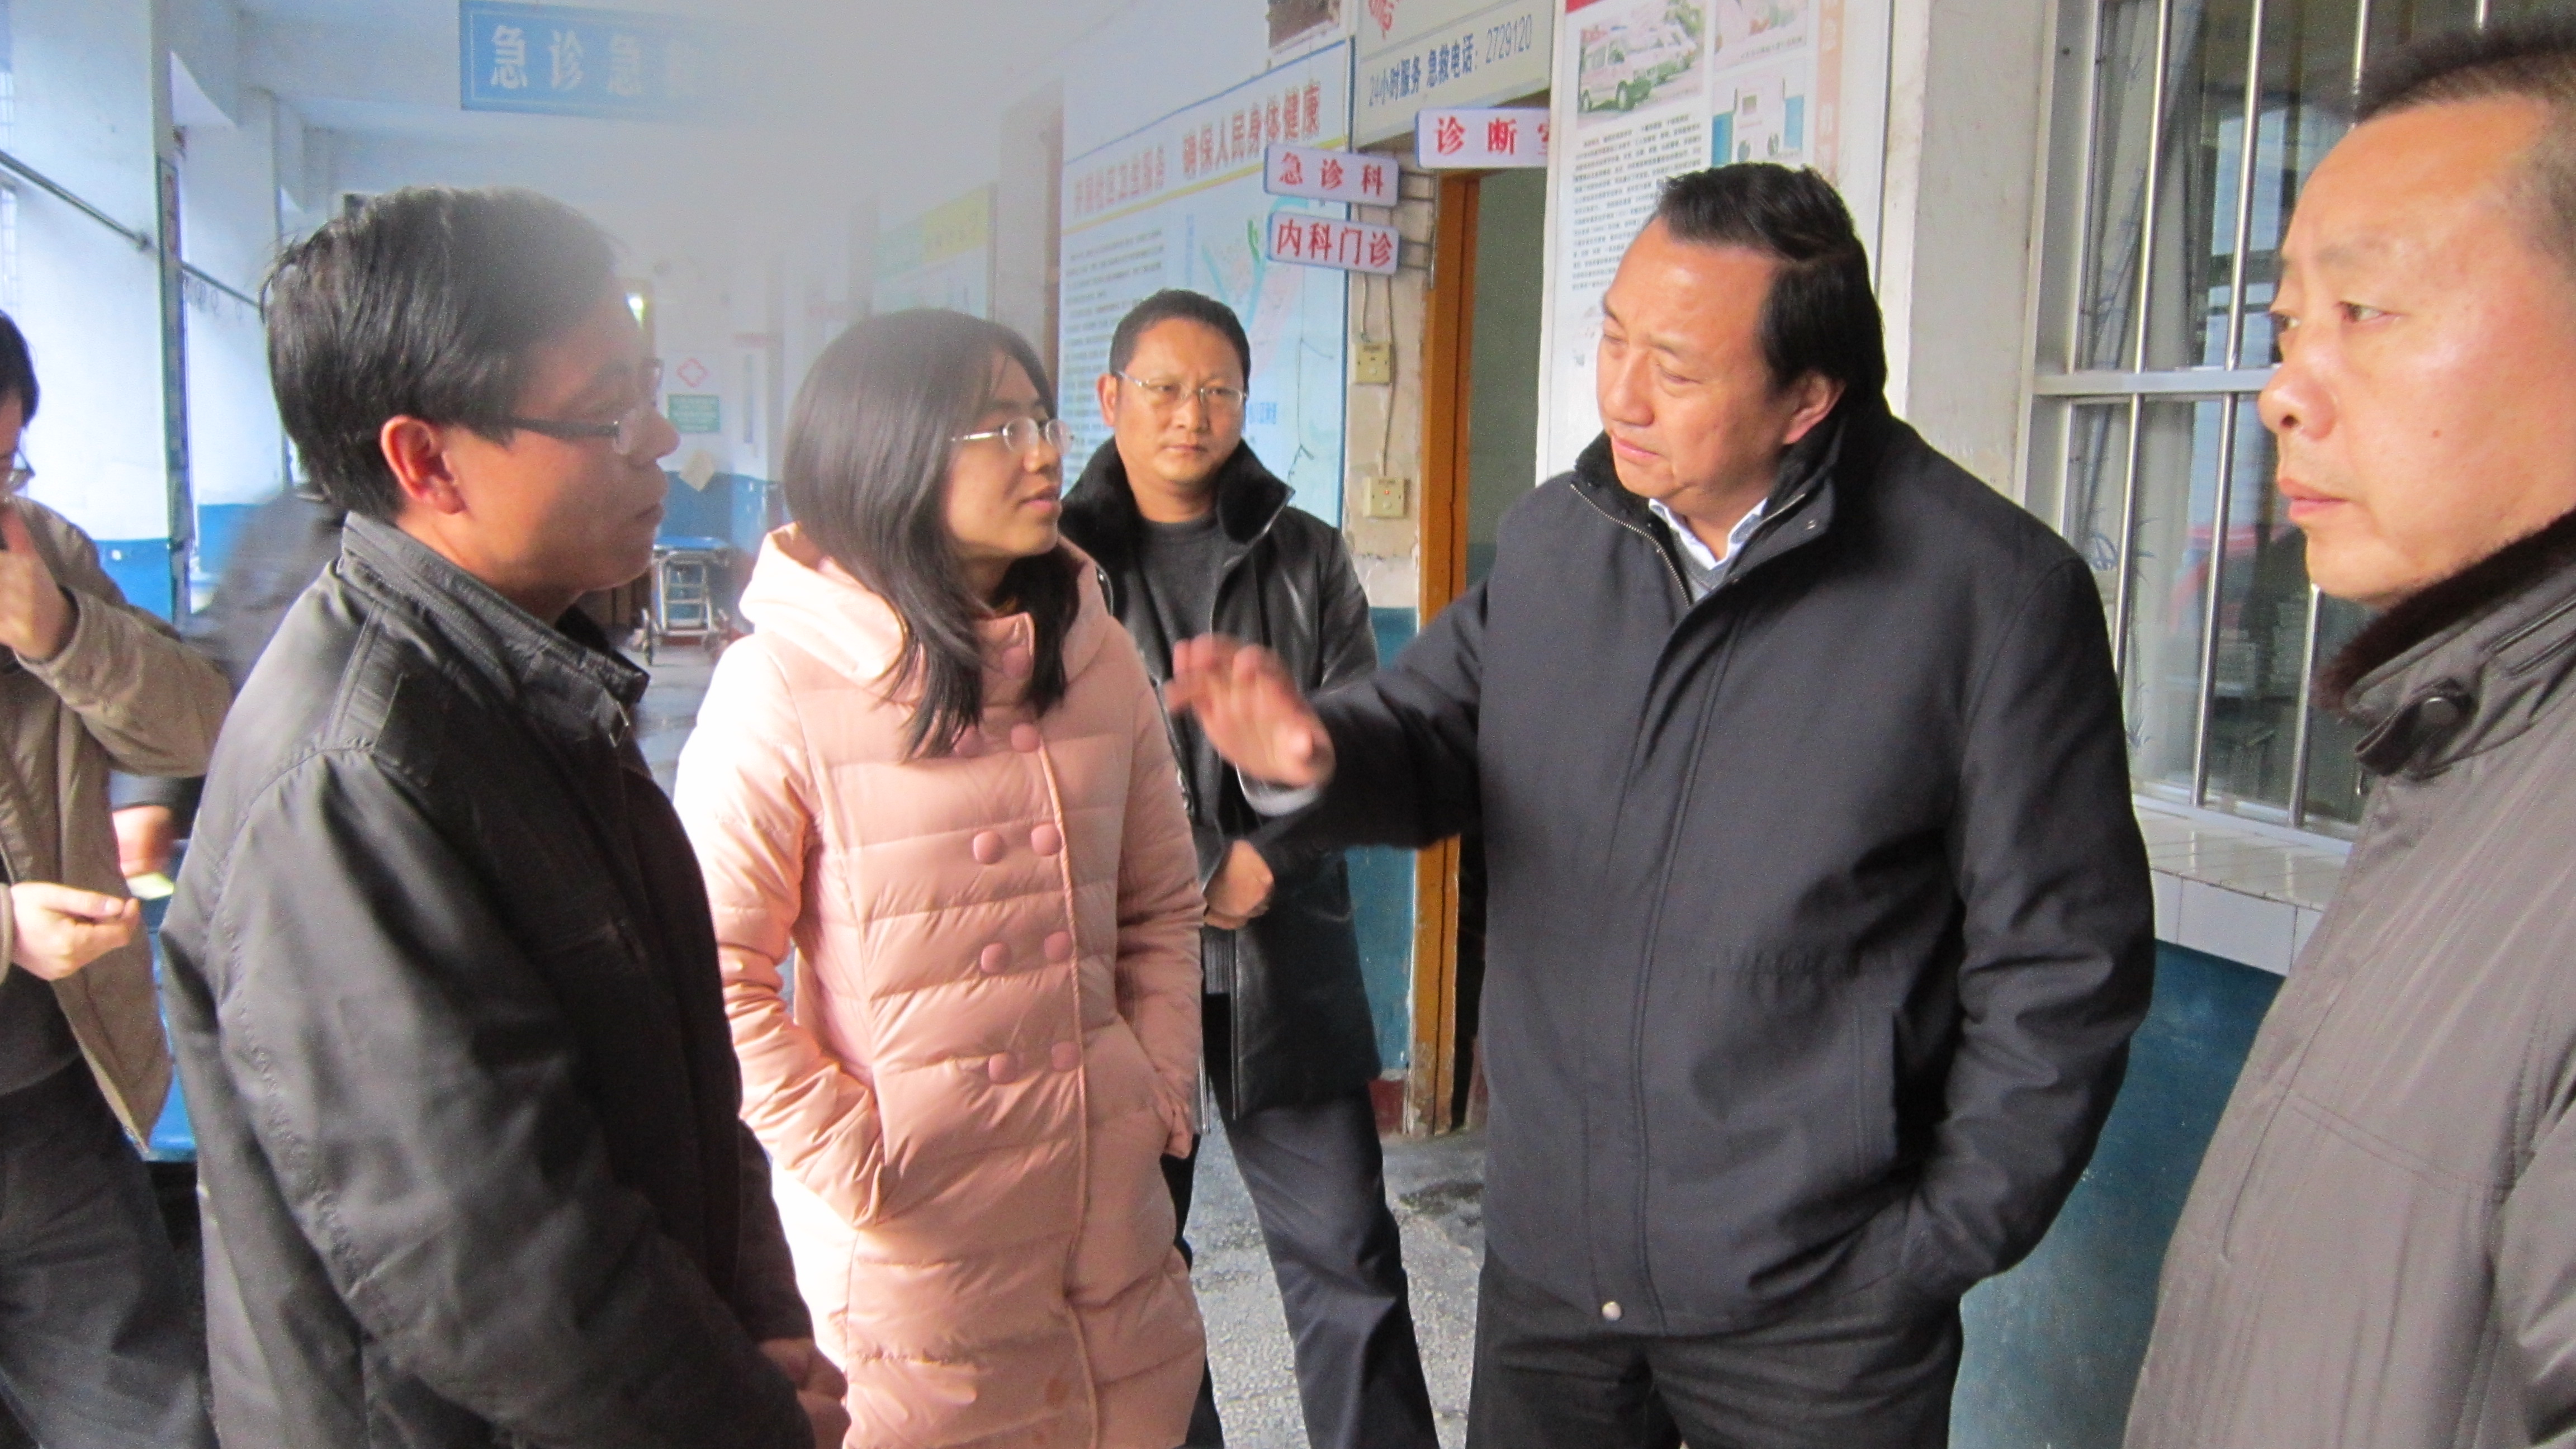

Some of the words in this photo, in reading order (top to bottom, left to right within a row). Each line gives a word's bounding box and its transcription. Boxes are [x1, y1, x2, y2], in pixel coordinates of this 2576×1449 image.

[490, 25, 699, 98] 急诊急
[1182, 77, 1321, 181] 确保人民身体健康
[1279, 151, 1384, 196] 急诊科
[1276, 219, 1393, 267] 内科门诊
